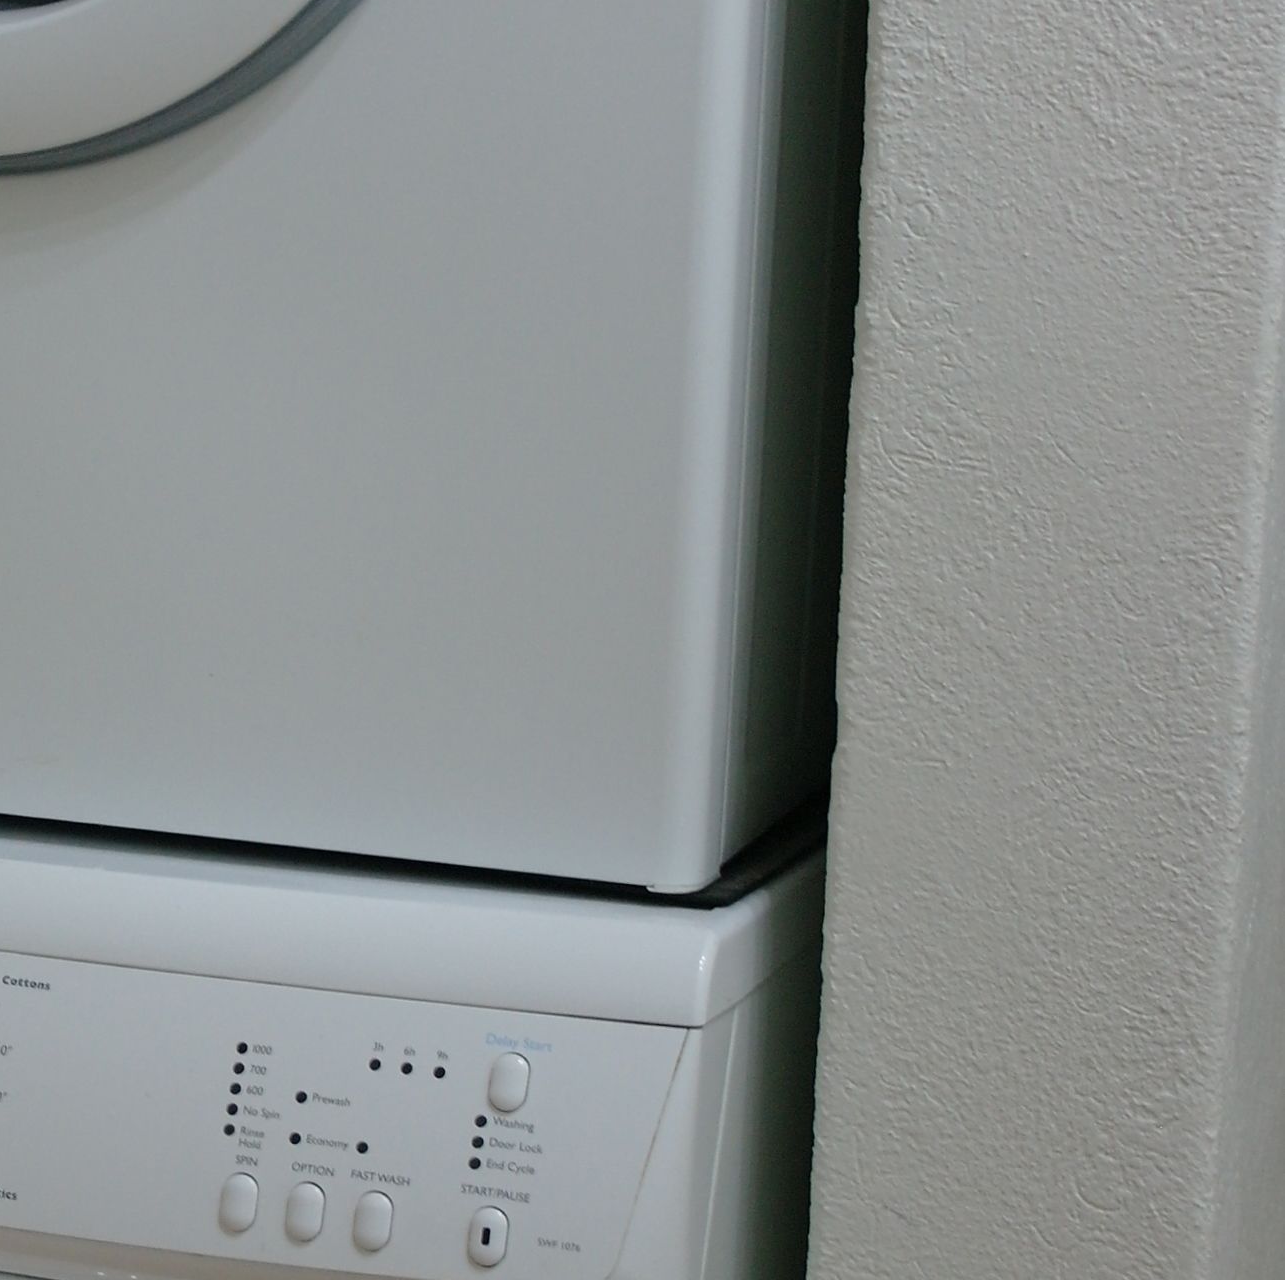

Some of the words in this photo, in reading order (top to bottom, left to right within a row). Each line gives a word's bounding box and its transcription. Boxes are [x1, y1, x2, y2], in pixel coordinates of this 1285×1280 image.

[2, 975, 51, 991] Cottons
[252, 1044, 272, 1055] 1000
[485, 1033, 518, 1050] Delay
[523, 1037, 552, 1052] Start
[250, 1064, 266, 1075] 700
[246, 1085, 263, 1096] 600
[312, 1092, 350, 1107] Prewash
[243, 1105, 258, 1115] No
[261, 1108, 280, 1120] Spin
[240, 1126, 265, 1138] Rinse
[493, 1116, 535, 1134] Washing
[238, 1138, 261, 1150] Hold
[306, 1134, 348, 1151] Economy
[489, 1137, 515, 1150] Door
[519, 1142, 542, 1154] Lock
[235, 1154, 258, 1166] SPIN
[486, 1158, 504, 1170] End
[507, 1161, 535, 1175] Cycle
[291, 1161, 335, 1177] OPTION
[350, 1169, 376, 1181] FAST
[377, 1172, 411, 1186] WASH
[460, 1183, 530, 1203] START/PAUSE
